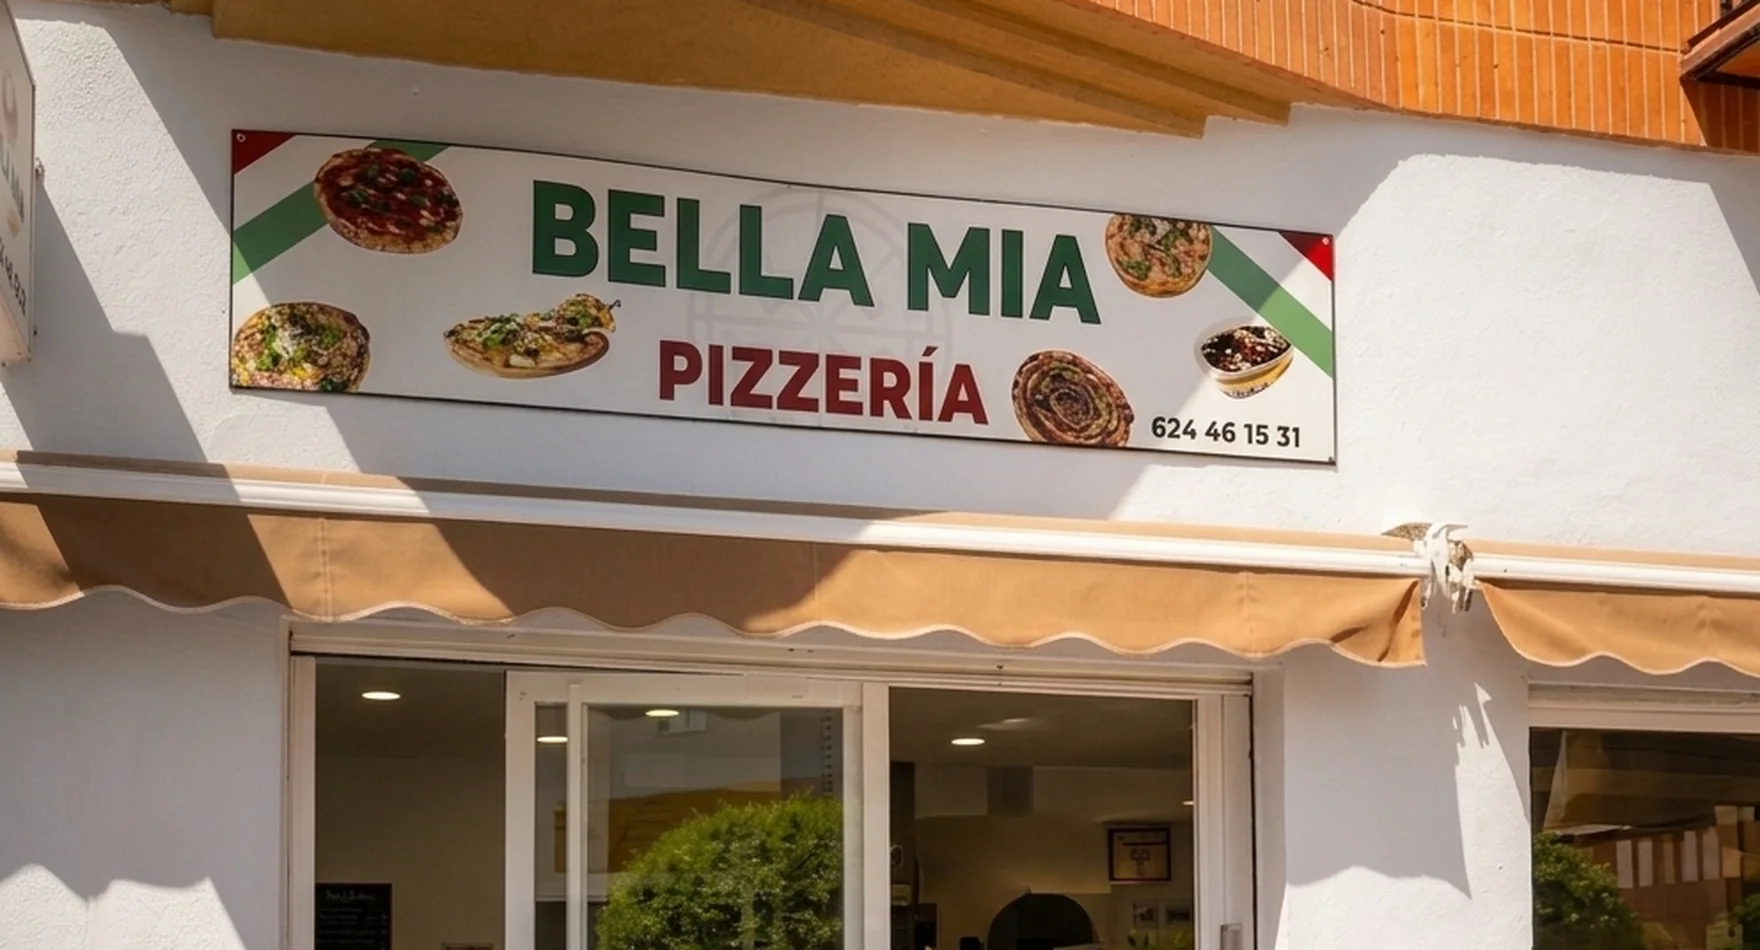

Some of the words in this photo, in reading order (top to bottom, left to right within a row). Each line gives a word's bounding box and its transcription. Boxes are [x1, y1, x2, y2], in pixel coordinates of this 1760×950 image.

[532, 180, 875, 308] BELLA
[907, 222, 1101, 325] MIA
[659, 340, 989, 425] PIZZERÍA
[1151, 416, 1197, 440] 624
[1205, 420, 1236, 443] 46
[1243, 423, 1269, 446] 15
[1276, 425, 1300, 448] 31
